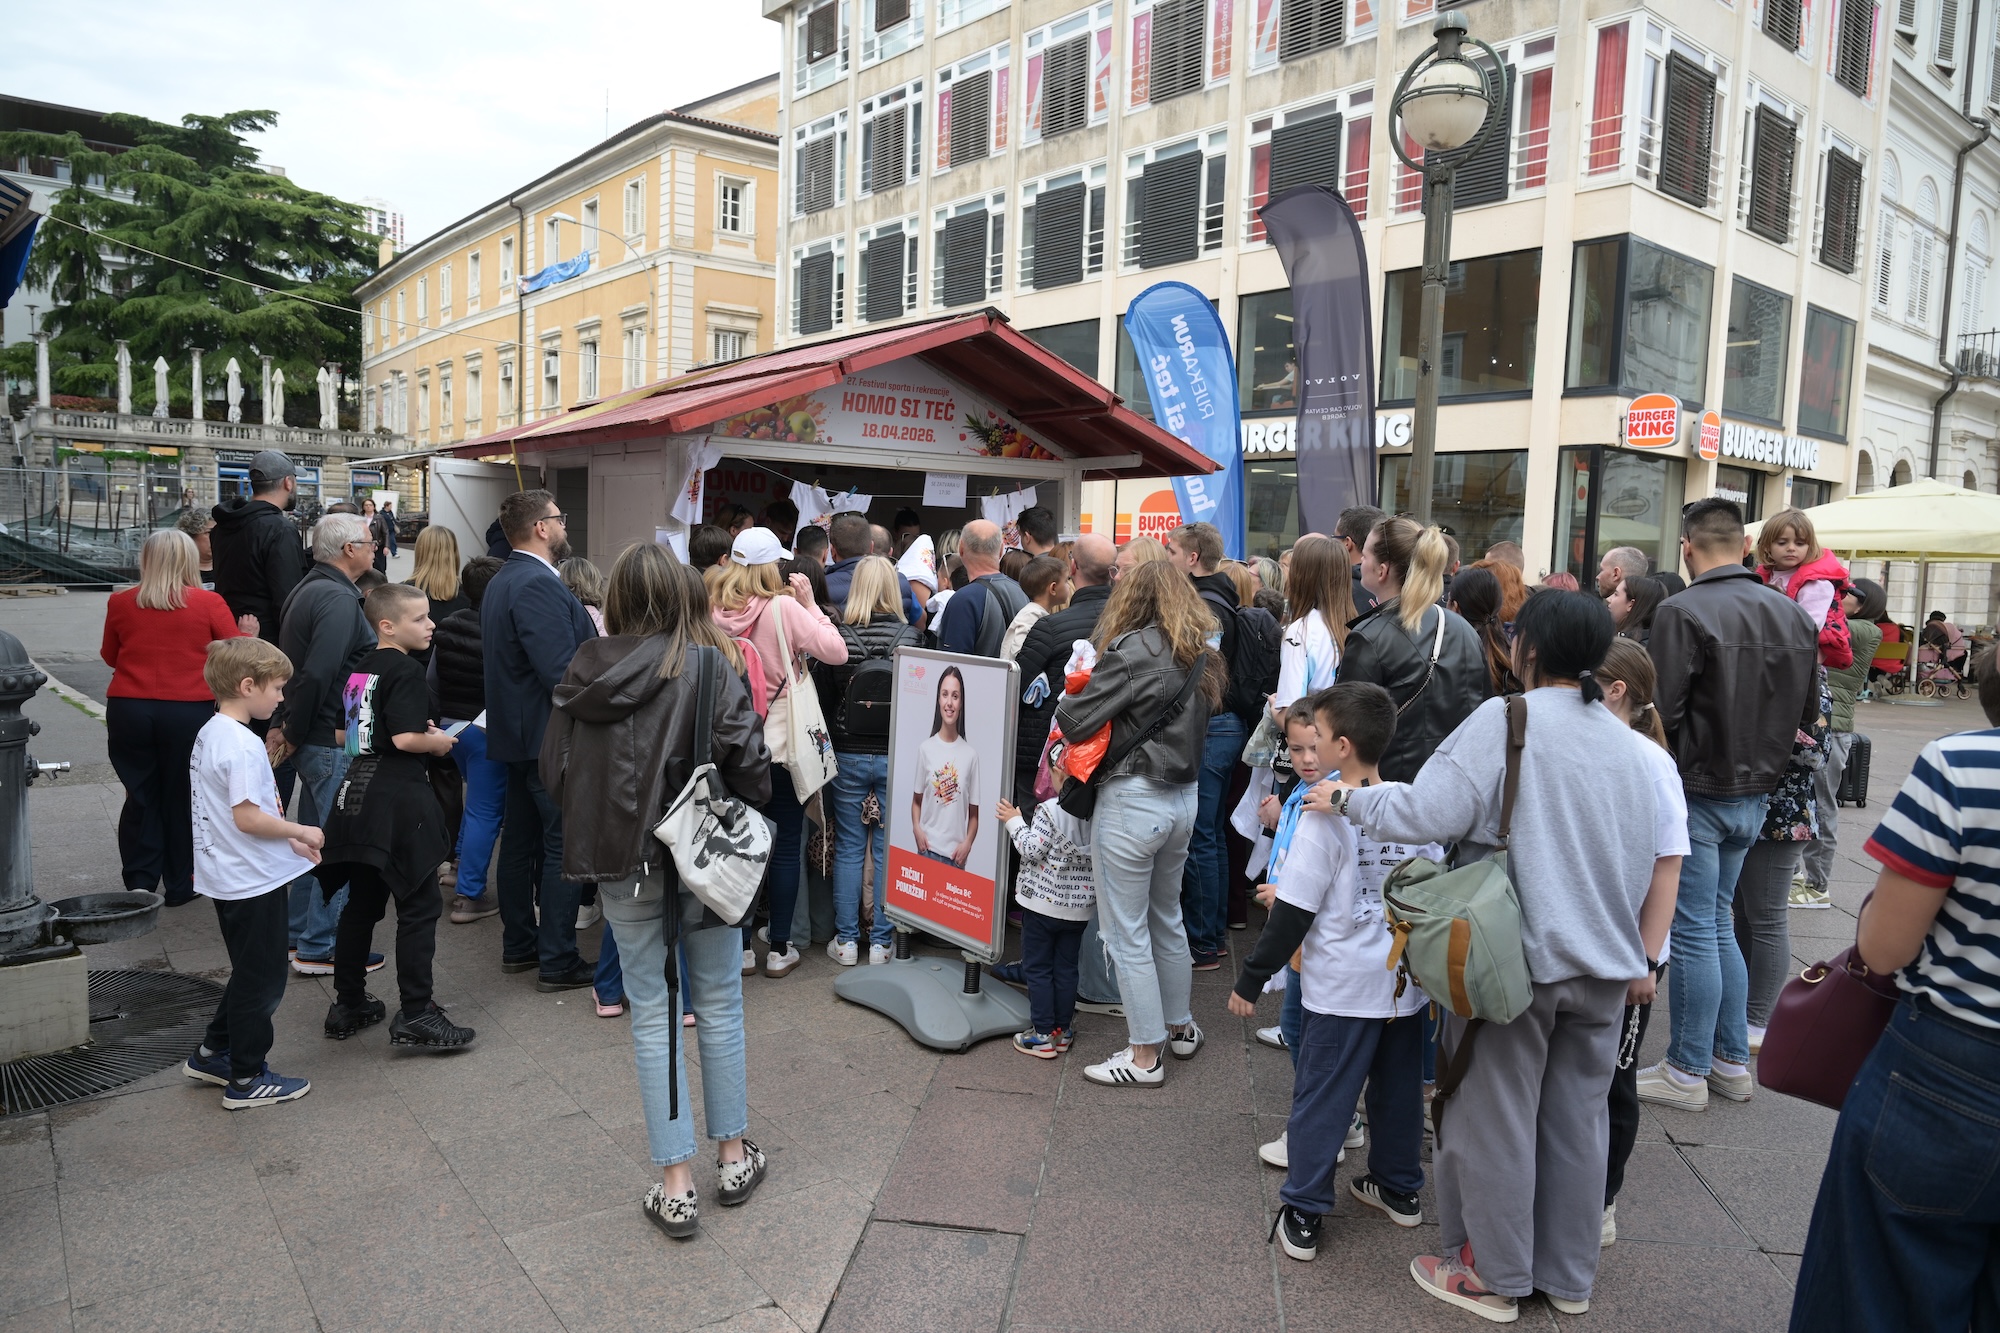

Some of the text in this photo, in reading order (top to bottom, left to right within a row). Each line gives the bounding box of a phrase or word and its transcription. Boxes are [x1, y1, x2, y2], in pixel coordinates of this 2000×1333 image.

[1138, 21, 1147, 80] ALGEBRA
[847, 376, 857, 386] 27.
[859, 378, 887, 389] Festival
[888, 382, 911, 391] sporta
[916, 385, 949, 397] rekreacije
[841, 391, 955, 421] HOMO SI TEĆ
[1630, 410, 1675, 422] BURGER
[861, 423, 936, 443] 18.04.2026.
[1628, 421, 1674, 437] KING
[1701, 425, 1719, 438] BURGER
[1700, 435, 1719, 451] KING
[1723, 423, 1820, 470] BURGER KING
[707, 469, 767, 493] OMO
[901, 866, 920, 883] TRČIM
[946, 882, 972, 899] Majica 8€
